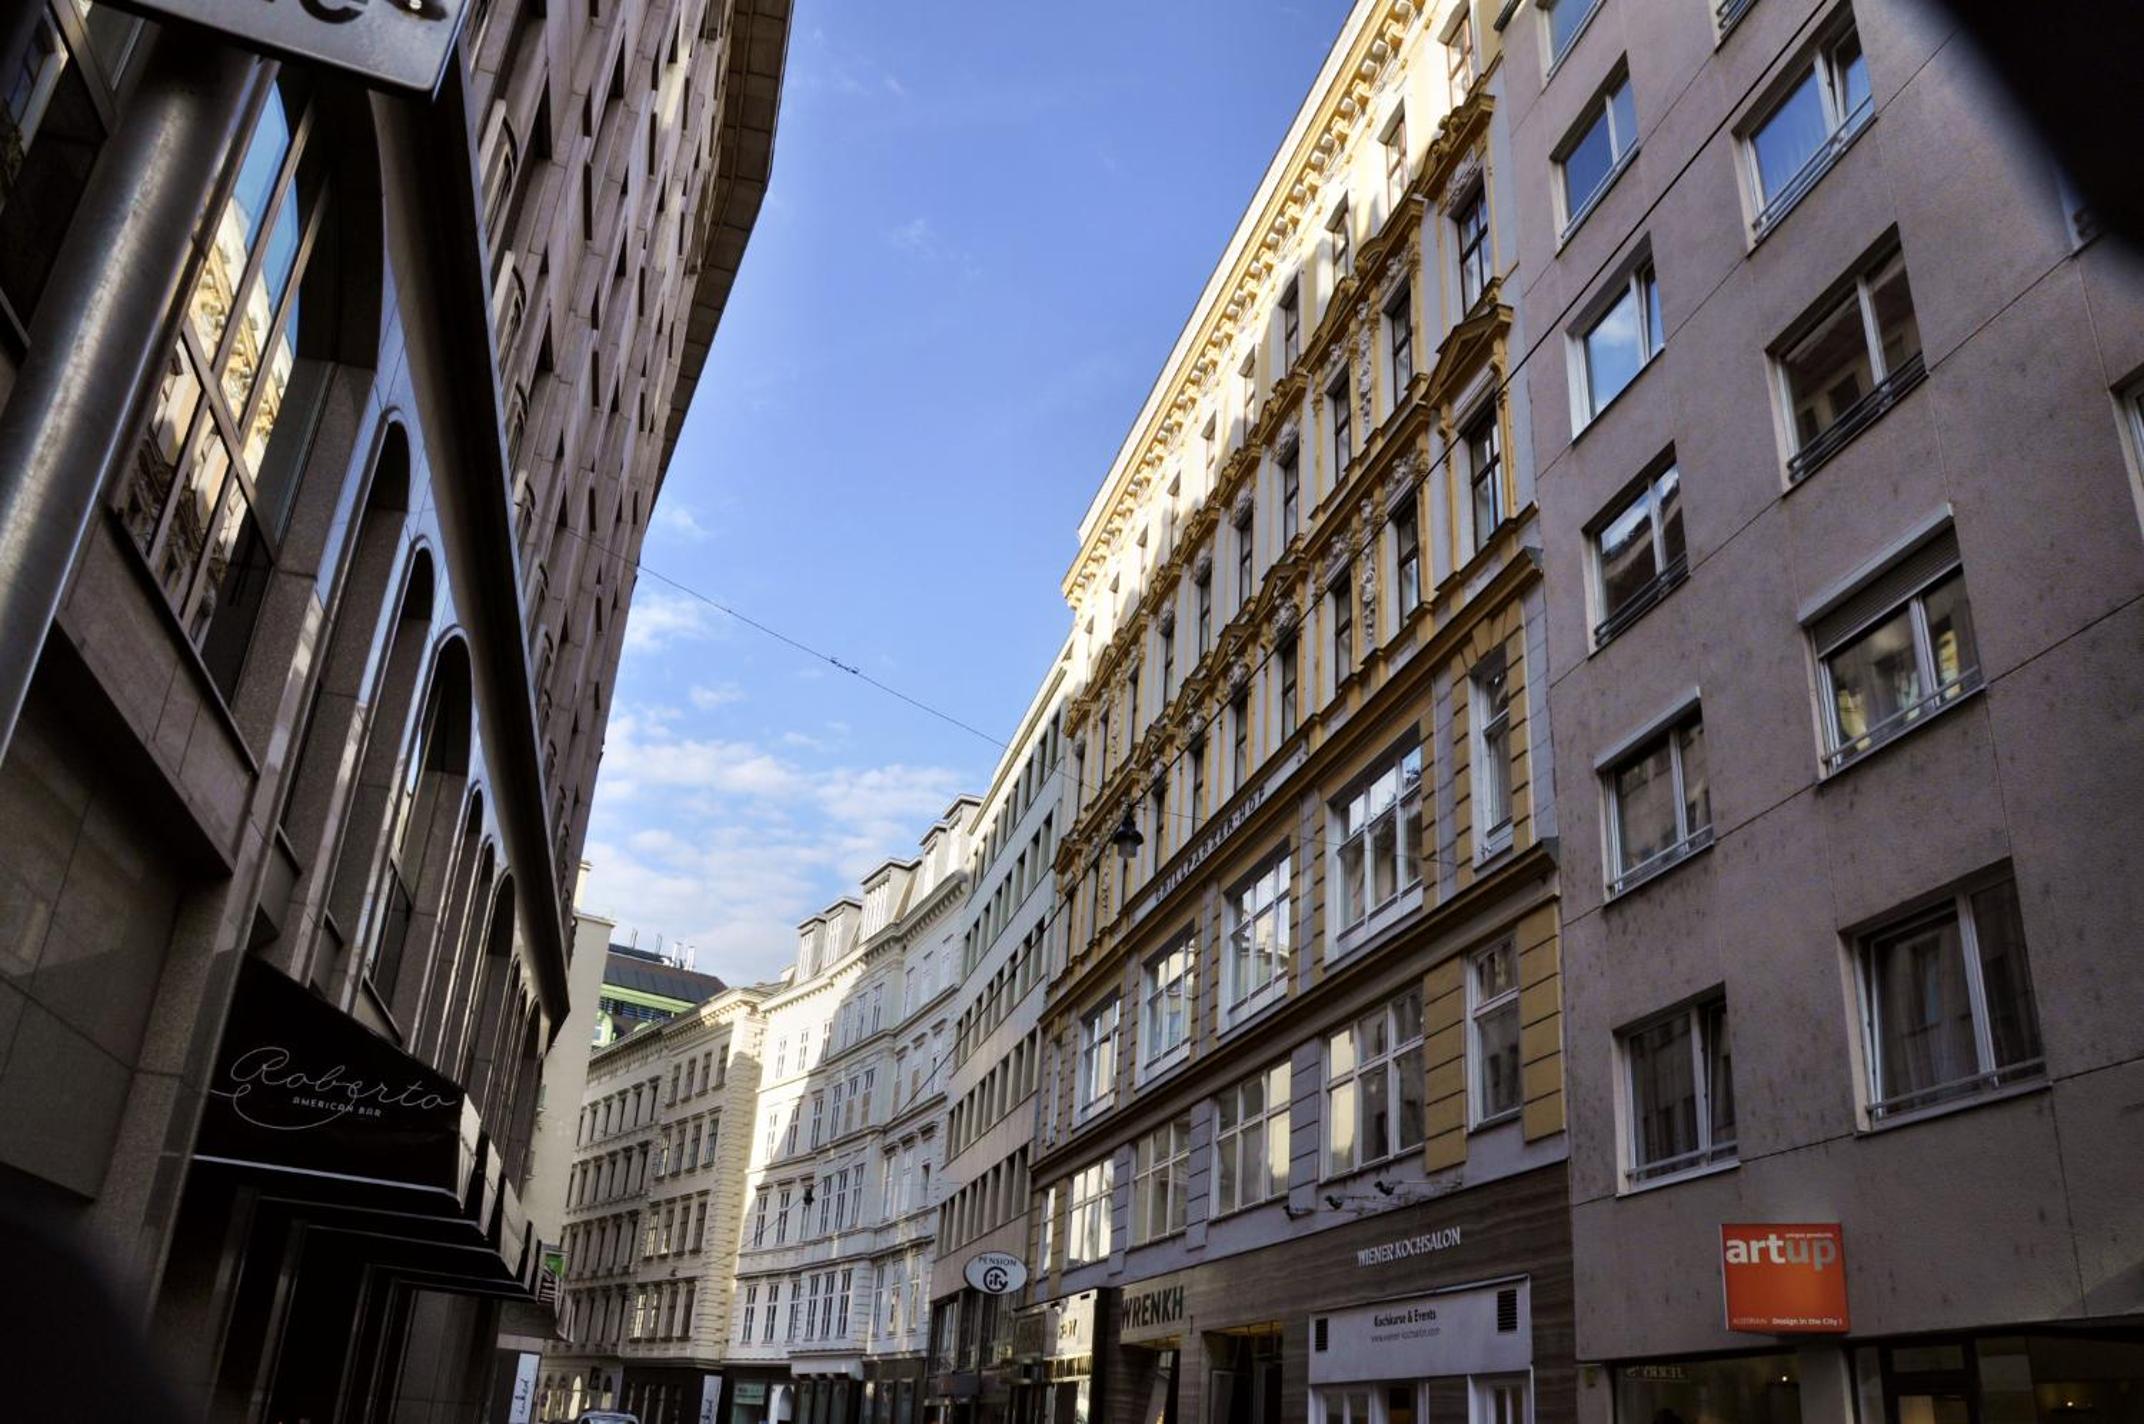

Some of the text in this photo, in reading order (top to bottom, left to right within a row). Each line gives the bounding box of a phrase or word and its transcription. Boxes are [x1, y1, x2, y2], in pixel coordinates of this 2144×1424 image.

[231, 1047, 456, 1109] Roberto
[292, 1097, 382, 1117] AMERICAN BAR
[978, 1256, 1017, 1266] PENSION
[1357, 1226, 1460, 1268] WIENER KOCHSALON
[1726, 1234, 1835, 1271] artup
[1121, 1286, 1184, 1330] WRENKH
